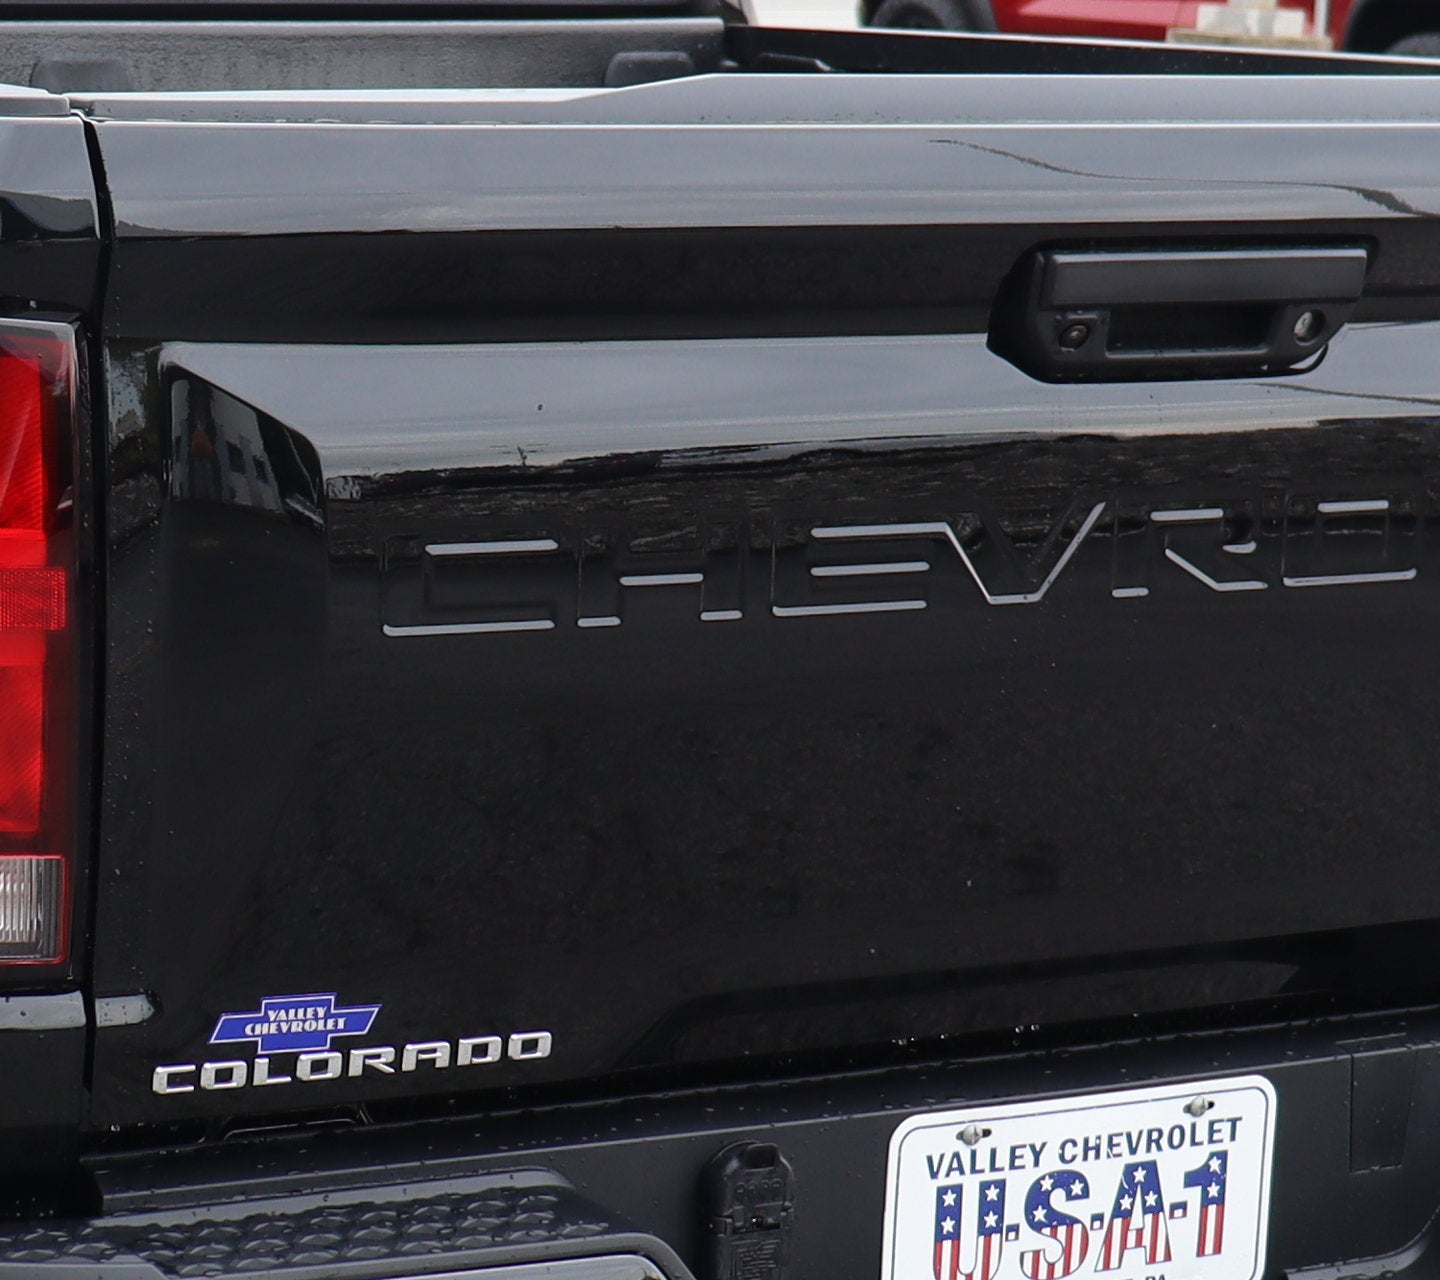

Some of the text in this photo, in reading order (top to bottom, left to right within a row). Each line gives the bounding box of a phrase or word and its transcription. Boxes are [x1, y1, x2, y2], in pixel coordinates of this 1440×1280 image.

[244, 1015, 348, 1037] CHEVROLET
[266, 1005, 328, 1022] VALLEY
[152, 1031, 553, 1096] COLORADO
[925, 1116, 1243, 1181] VALLEY CHEVROLET
